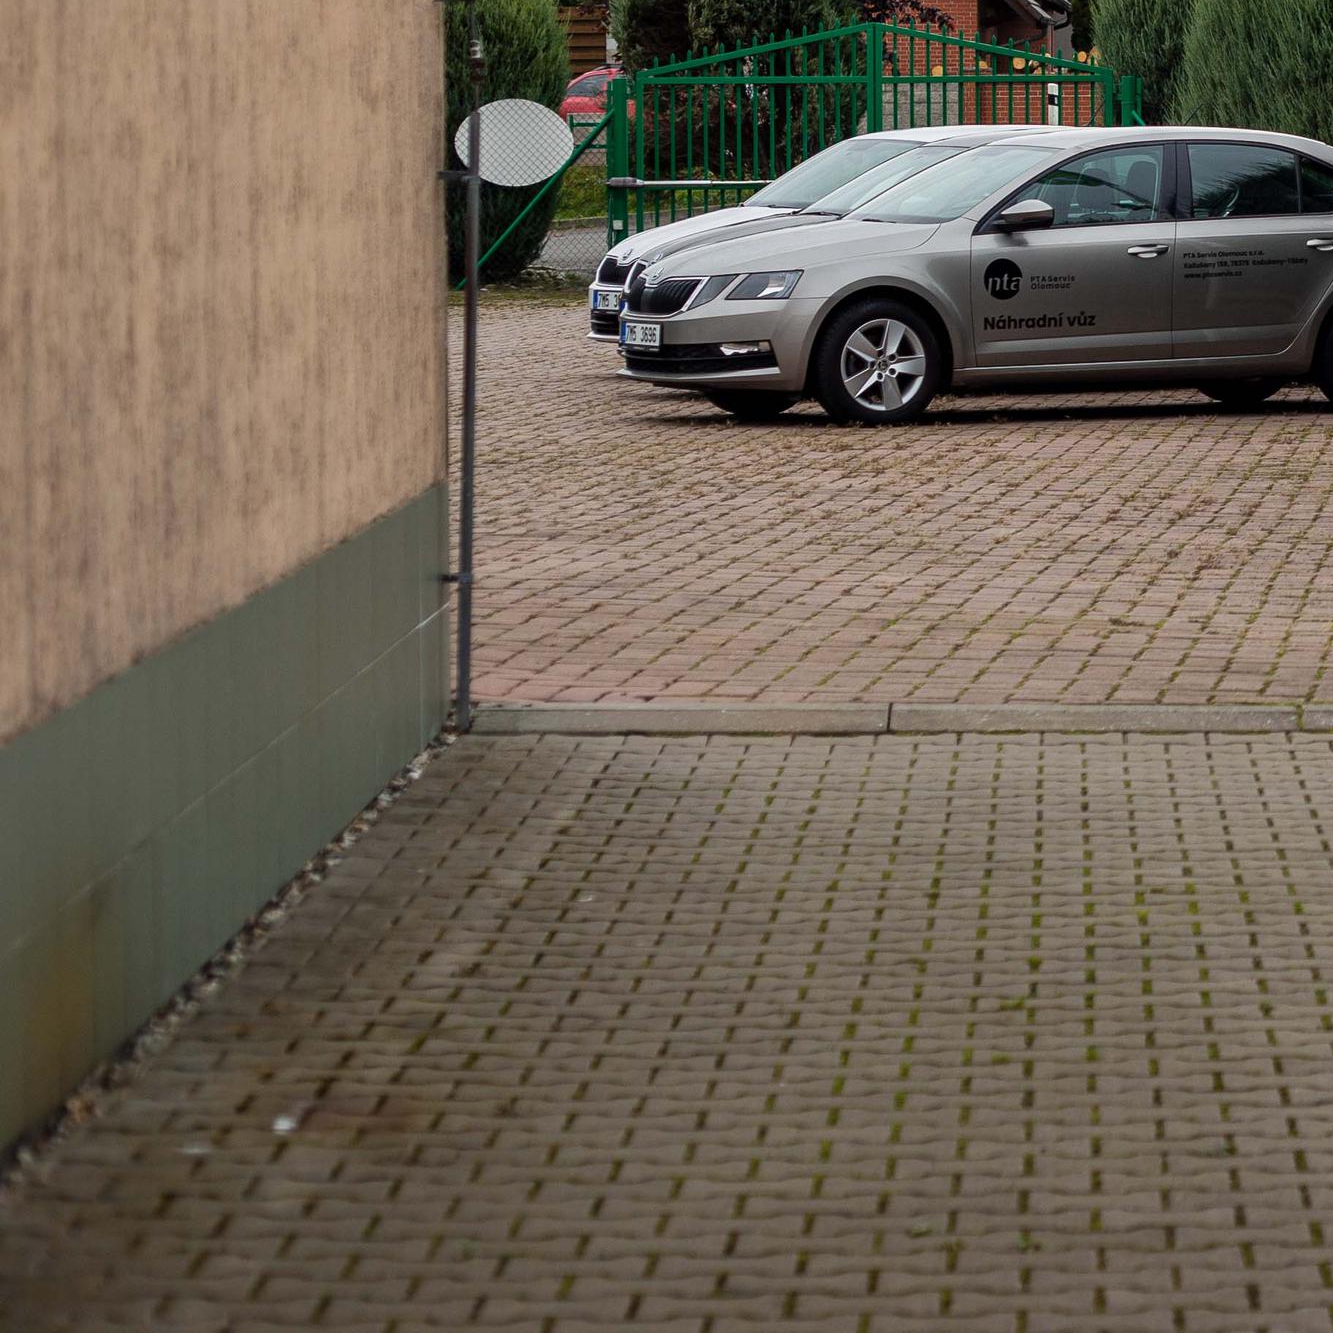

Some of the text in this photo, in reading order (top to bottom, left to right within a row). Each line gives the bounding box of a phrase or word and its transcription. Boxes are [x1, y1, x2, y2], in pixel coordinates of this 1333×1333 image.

[988, 273, 1023, 296] pta
[983, 311, 1097, 331] Náhradní vůz
